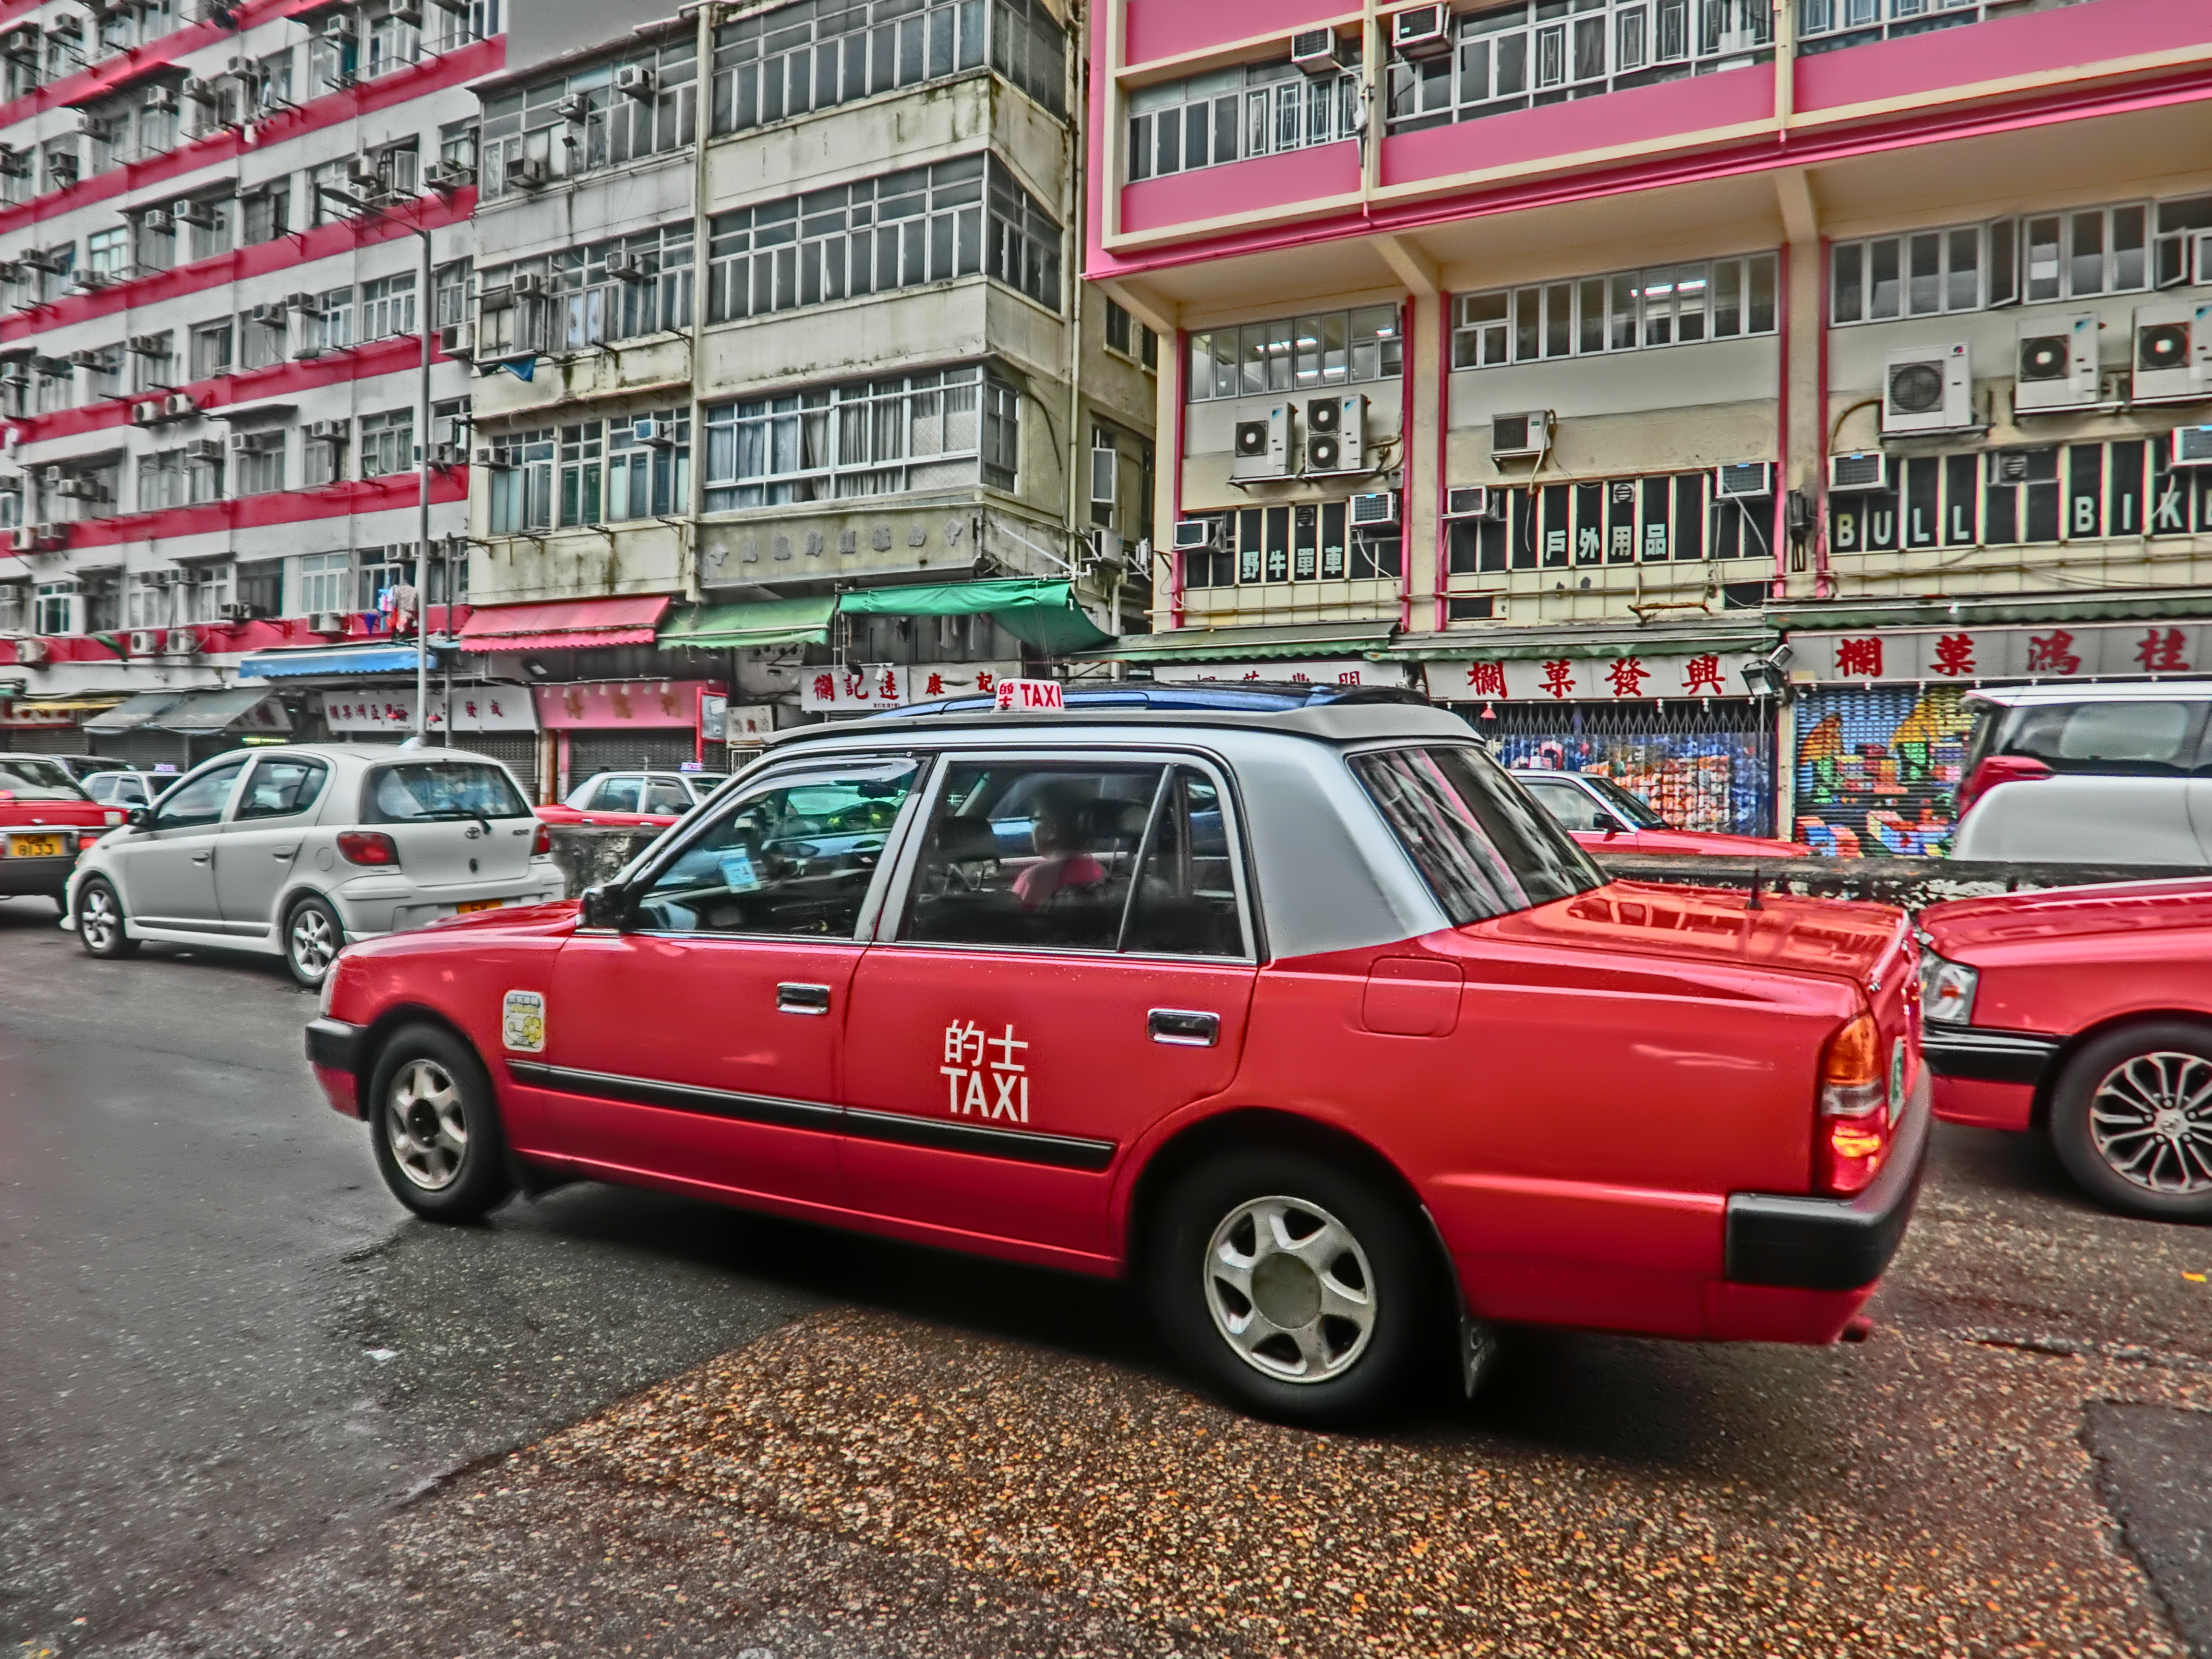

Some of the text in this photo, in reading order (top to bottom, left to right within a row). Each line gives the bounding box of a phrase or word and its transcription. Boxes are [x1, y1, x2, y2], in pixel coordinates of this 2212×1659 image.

[1545, 523, 1666, 561] 戶外用品
[1837, 505, 1970, 547] BULL
[1242, 546, 1343, 579] 野牛單車
[998, 682, 1014, 707] 的士
[1020, 683, 1062, 708] TAXI
[18, 844, 54, 855] 8133
[944, 1019, 1029, 1072] 的士
[939, 1066, 1029, 1123] TAXI
